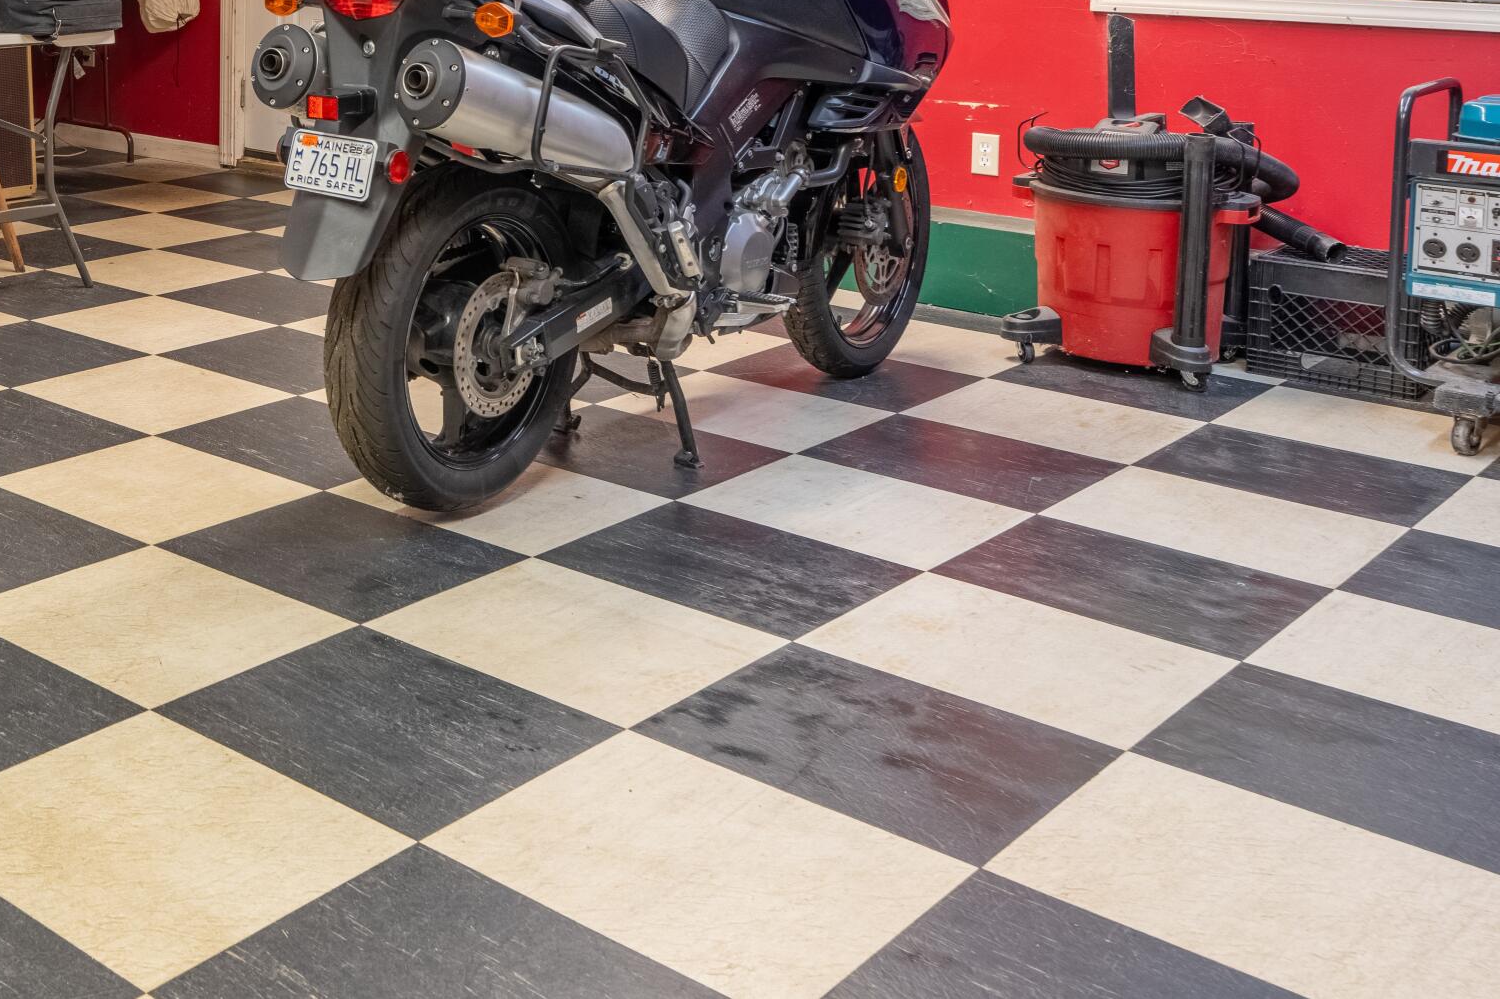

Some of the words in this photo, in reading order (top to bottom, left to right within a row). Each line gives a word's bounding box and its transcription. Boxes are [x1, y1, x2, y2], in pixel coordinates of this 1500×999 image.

[316, 140, 350, 154] MAINE
[309, 149, 340, 178] 765
[344, 156, 364, 183] HL
[296, 174, 321, 186] RIDE
[326, 180, 355, 193] SAFE
